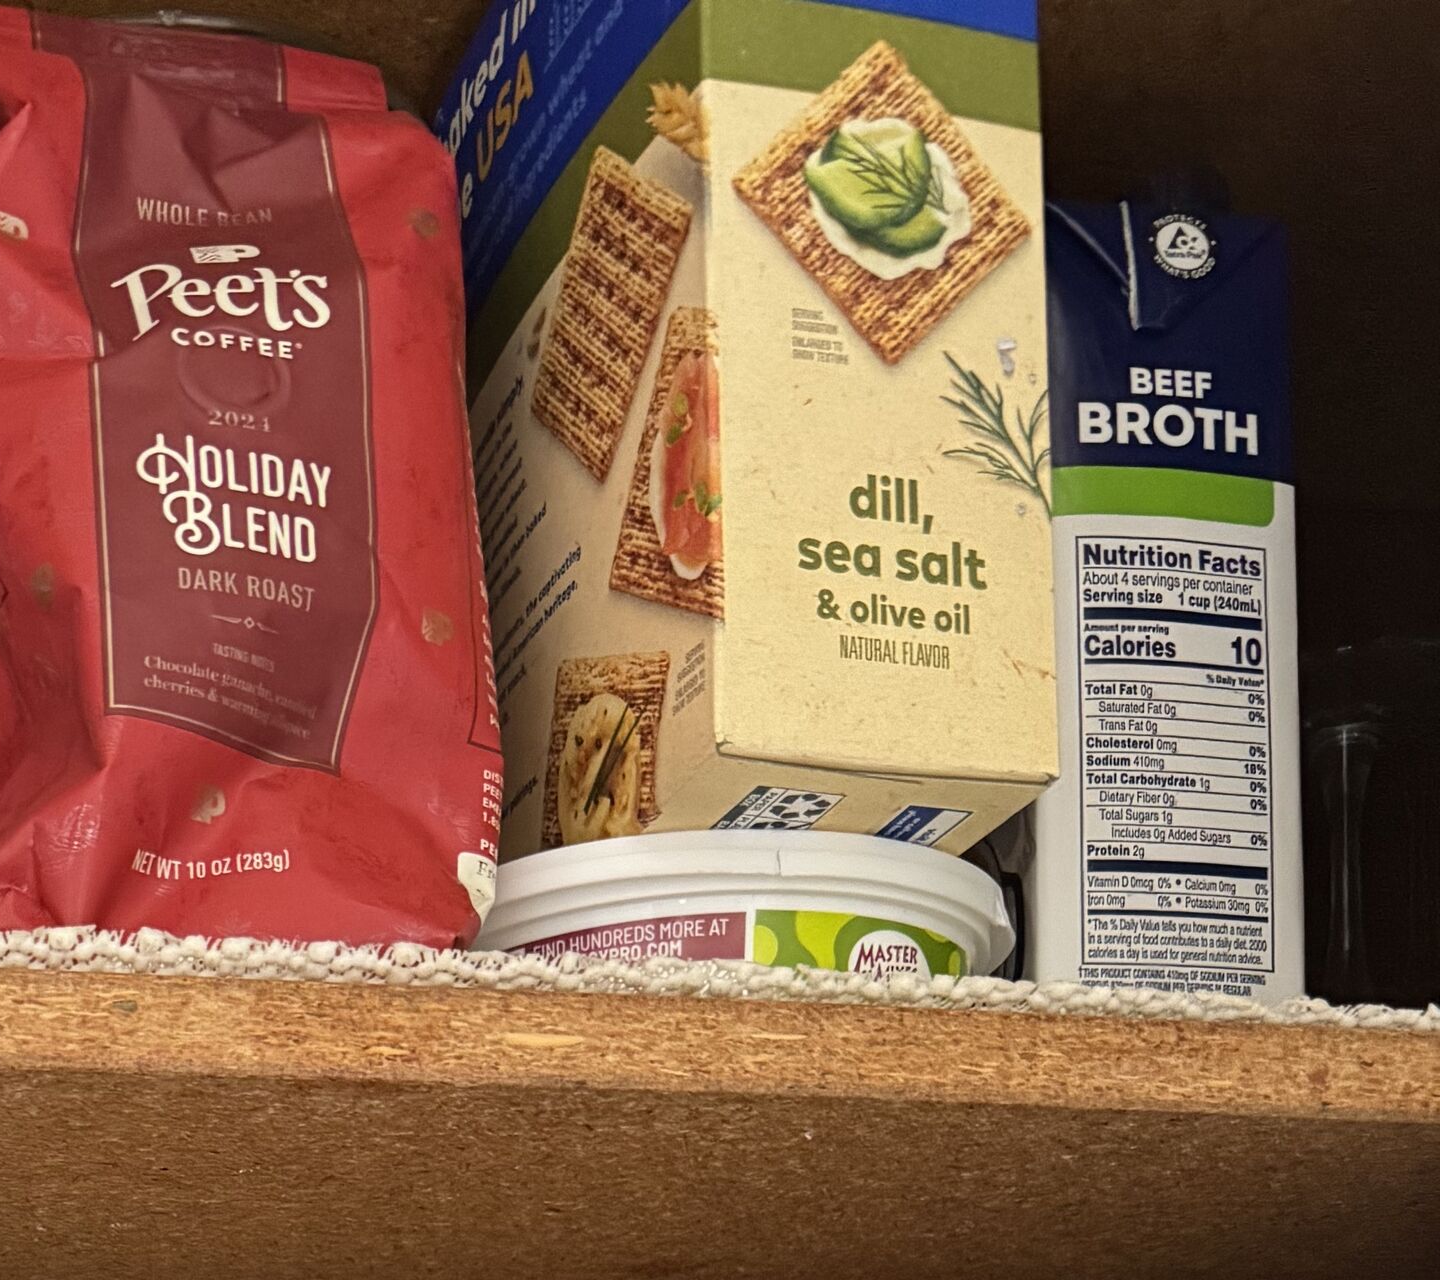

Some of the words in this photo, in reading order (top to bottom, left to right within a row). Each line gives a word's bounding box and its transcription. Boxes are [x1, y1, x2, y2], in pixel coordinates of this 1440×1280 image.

[477, 50, 534, 182] USA
[136, 197, 208, 227] WHOLE
[216, 208, 272, 228] BEAN
[111, 264, 331, 342] Peet's
[171, 327, 294, 359] COFFEE
[1130, 367, 1212, 399] BEEF
[208, 409, 272, 433] 2024
[1078, 401, 1259, 456] BROTH
[849, 473, 934, 535] dill,
[162, 489, 317, 563] BLEND
[798, 537, 881, 578] sea
[895, 541, 988, 591] salt
[1083, 544, 1192, 570] Nutrition
[1199, 550, 1260, 576] Facts
[178, 567, 238, 595] DARK
[247, 575, 315, 613] ROAST
[1083, 571, 1118, 585] About
[1121, 573, 1128, 585] 4
[1132, 574, 1180, 590] servings
[1183, 577, 1200, 591] per
[1203, 578, 1253, 595] container
[817, 588, 841, 621] &
[850, 592, 925, 630] olive
[934, 602, 971, 635] oil
[1083, 588, 1133, 604] Serving
[1138, 591, 1163, 603] size
[1178, 592, 1184, 605] 1
[1189, 595, 1210, 610] cup
[1214, 596, 1261, 615] (240mL)
[839, 634, 898, 665] NATURAL
[902, 641, 951, 670] FLAVOR
[1085, 635, 1176, 658] Calories
[1231, 636, 1261, 666] 10
[1099, 701, 1145, 714] Saturated
[1086, 737, 1154, 750] Cholesterol
[132, 848, 155, 876] NET
[157, 856, 181, 881] WT
[186, 861, 206, 879] 10
[237, 849, 290, 873] (283g)
[1087, 845, 1130, 856] Protein
[569, 924, 655, 952] HUNDREDS
[660, 920, 705, 939] MORE
[709, 918, 729, 936] AT
[856, 943, 919, 973] MASTER
